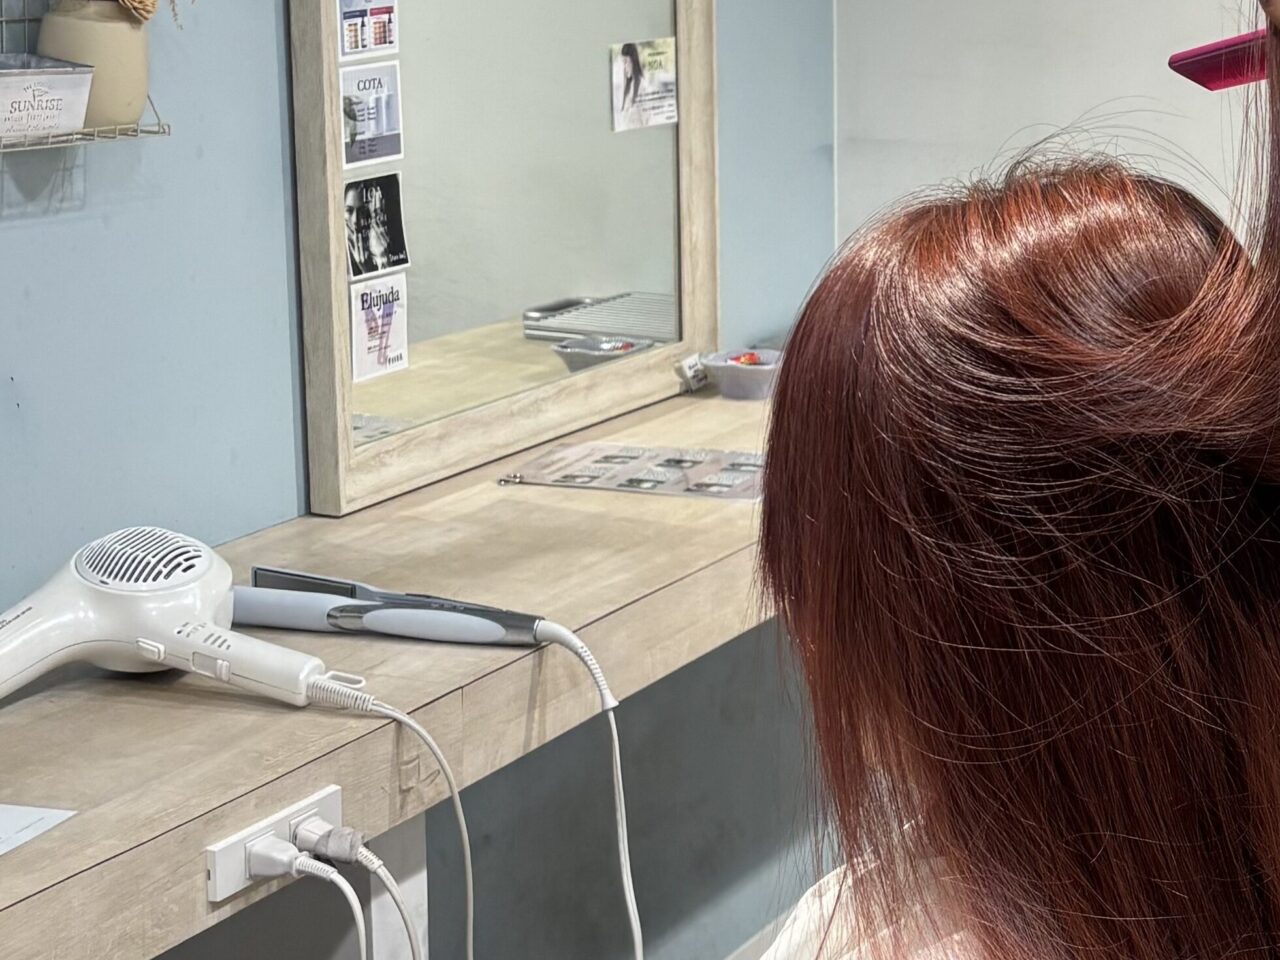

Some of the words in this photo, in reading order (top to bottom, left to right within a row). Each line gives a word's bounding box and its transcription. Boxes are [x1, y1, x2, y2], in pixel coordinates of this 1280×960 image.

[357, 77, 384, 92] COTA
[9, 98, 64, 114] SUNRISE
[360, 286, 400, 311] Elujuda
